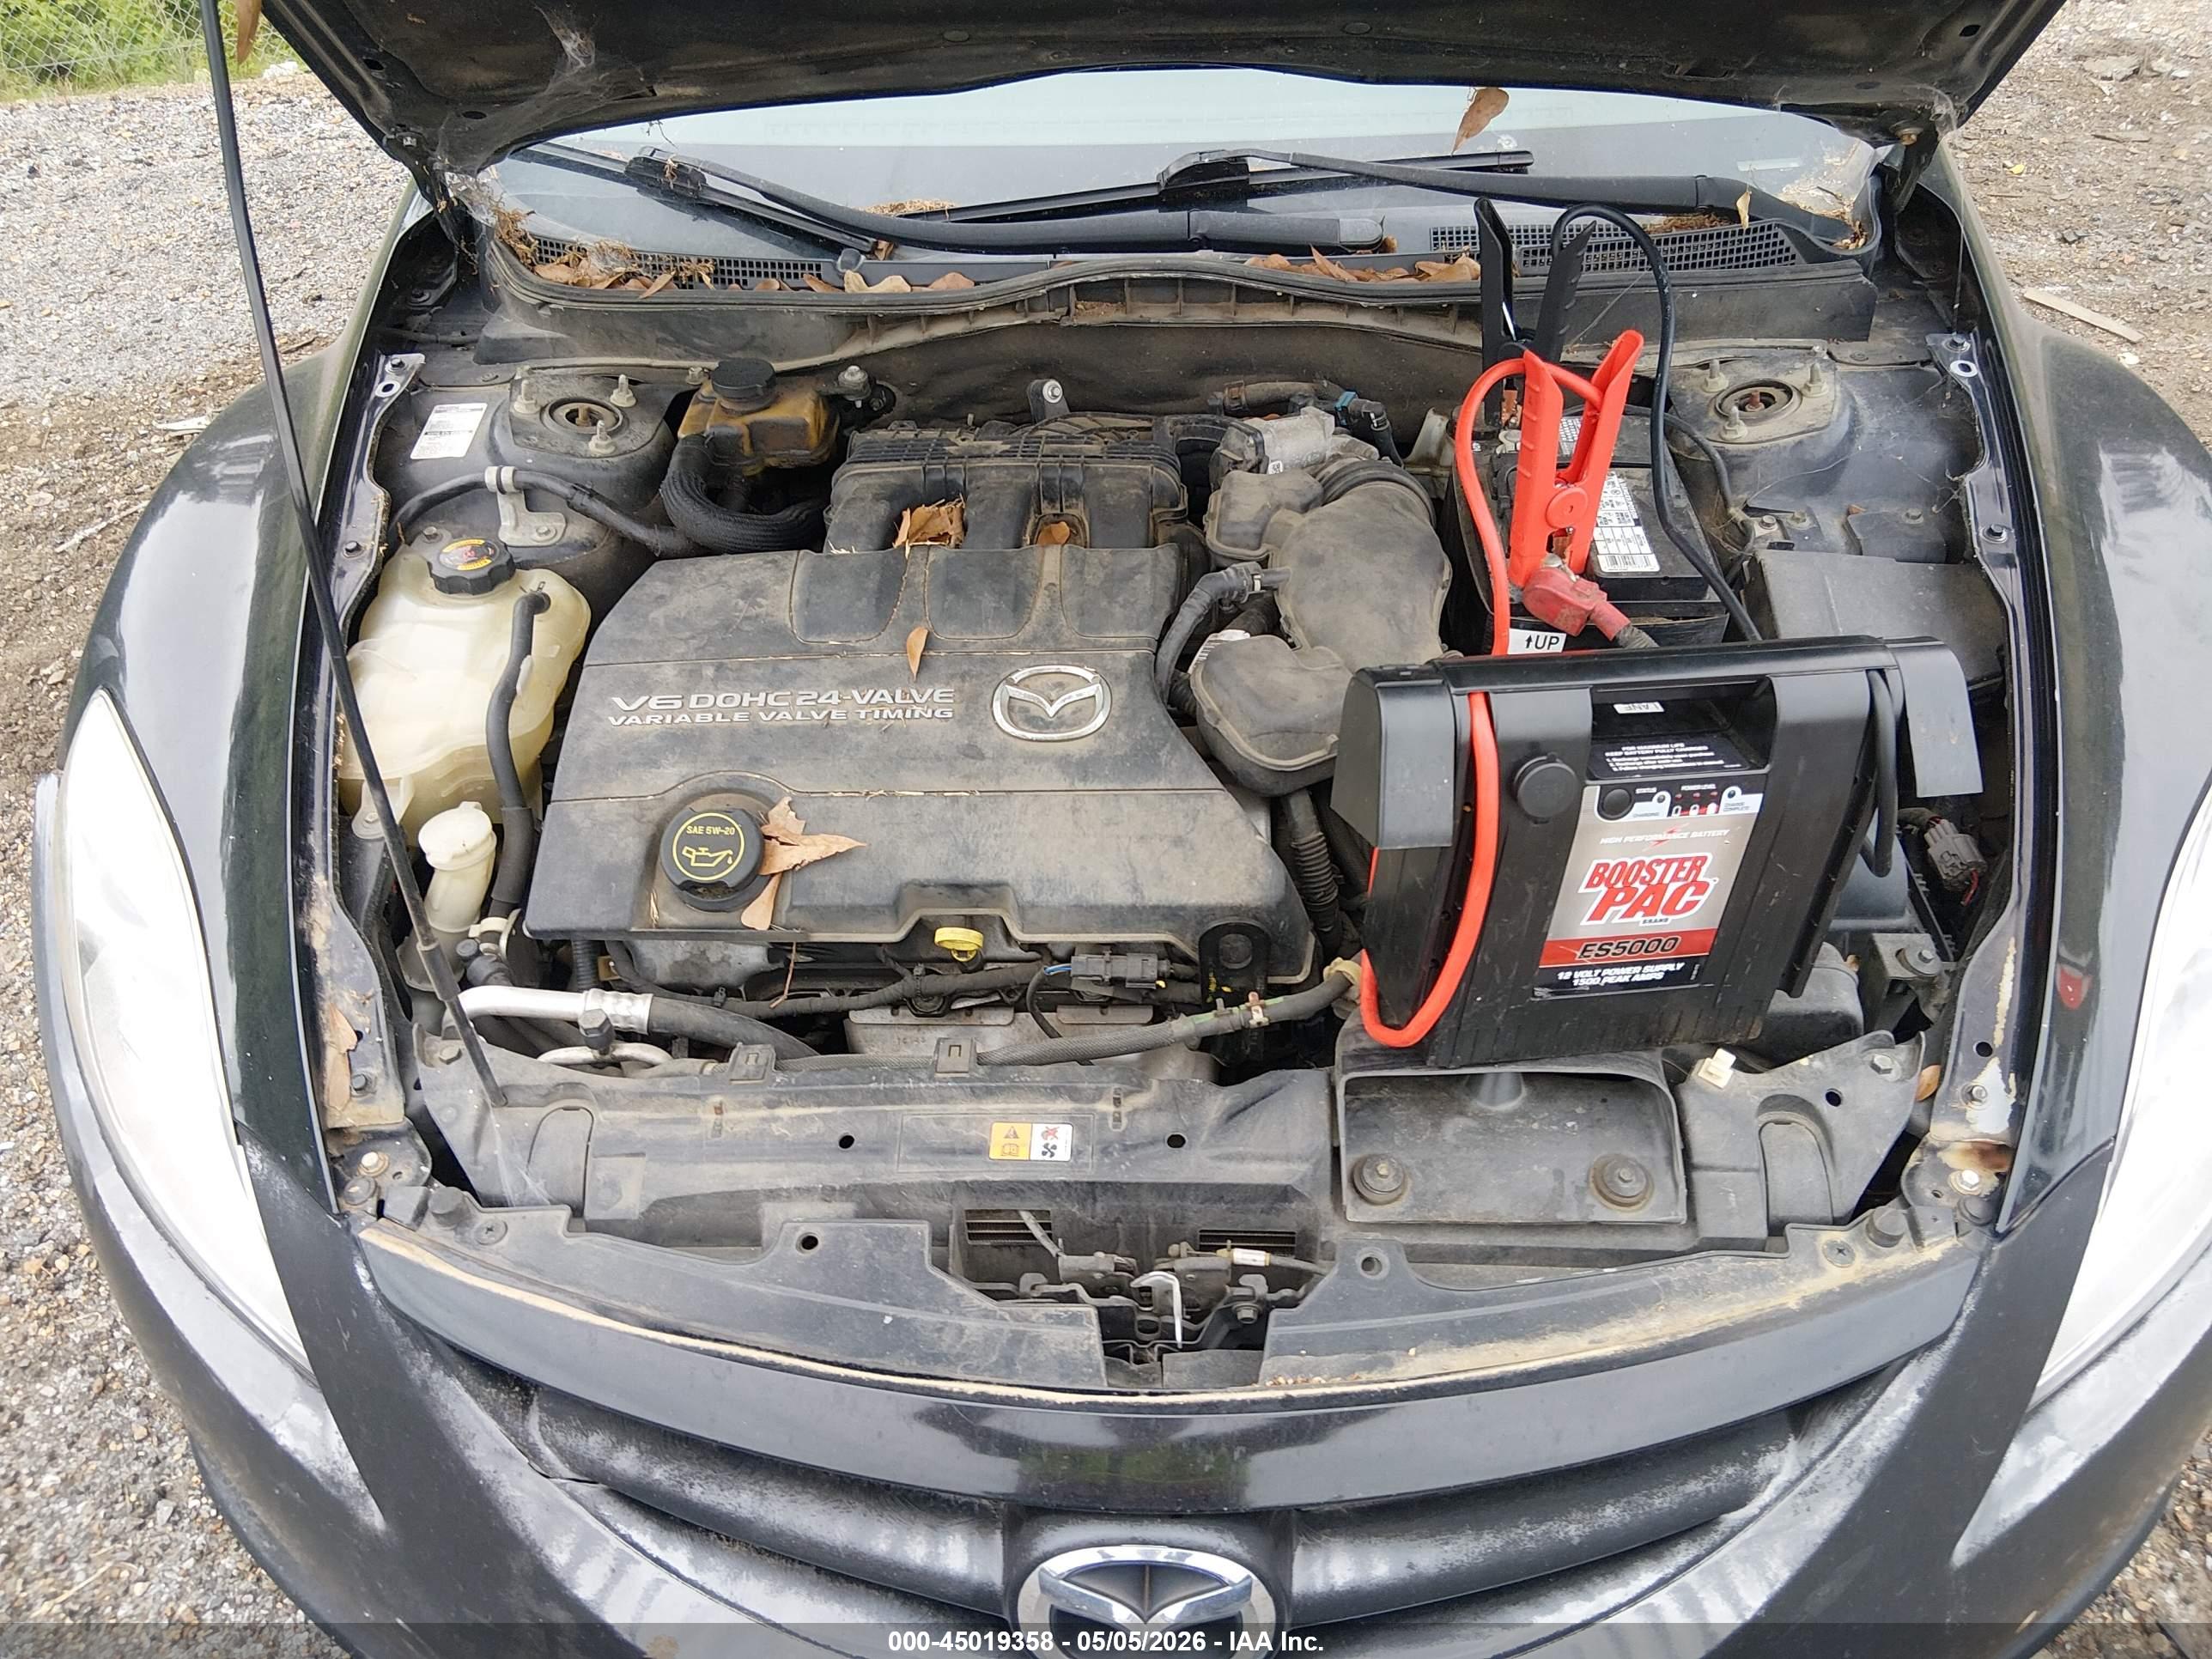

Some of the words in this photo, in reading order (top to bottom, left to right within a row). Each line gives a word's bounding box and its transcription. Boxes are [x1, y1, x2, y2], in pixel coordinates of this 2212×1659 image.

[1534, 635, 1559, 650] UP
[611, 694, 684, 711] V6
[689, 691, 791, 708] DOHC
[796, 688, 955, 706] 24-VALVE
[608, 711, 750, 726] VARIABLE
[759, 709, 848, 721] VALVE
[855, 708, 954, 720] TIMING
[686, 825, 704, 834] SAE
[705, 826, 735, 836] 5W-20
[1600, 836, 1623, 844] HIGH
[1623, 831, 1690, 843] PERFORMANCE
[1690, 829, 1730, 839] BATTERY
[1585, 855, 1709, 888] BOOSTER
[1586, 880, 1711, 921] PAC
[1577, 936, 1680, 959] ES5000
[1557, 970, 1573, 981] 12
[1573, 969, 1601, 978] VOLT
[1601, 966, 1642, 977] POWER
[1641, 962, 1686, 974] SUPPLY
[1572, 976, 1602, 986] 1500
[1601, 974, 1633, 985] PEAK
[1632, 971, 1665, 981] AMPS
